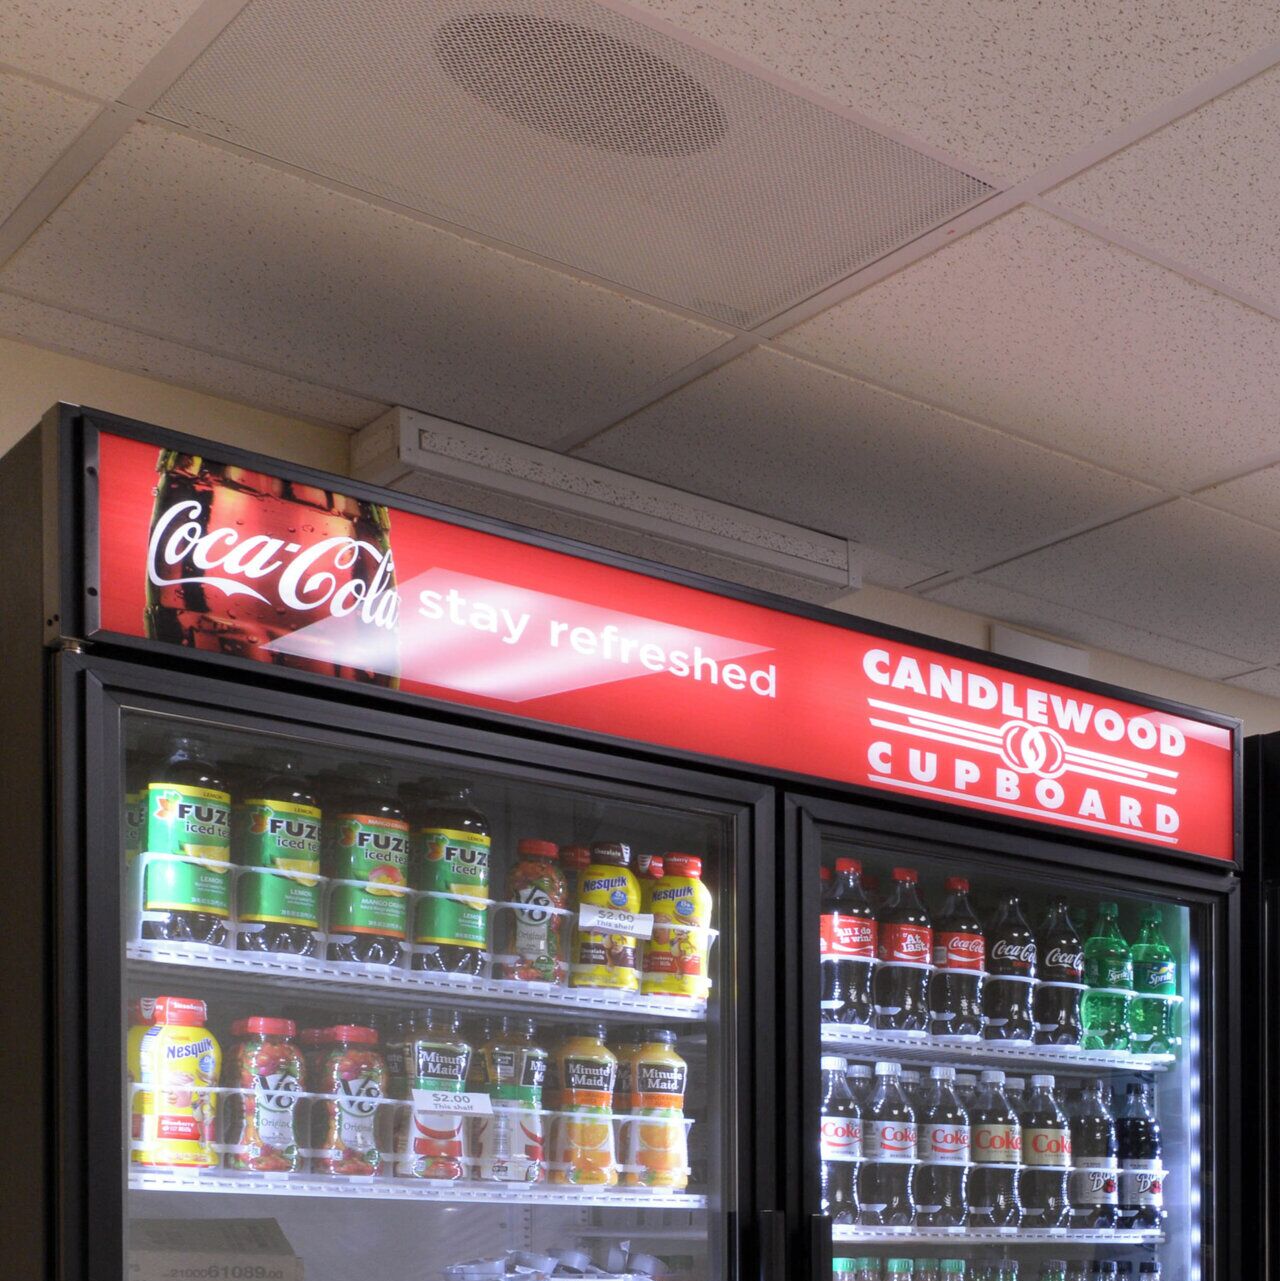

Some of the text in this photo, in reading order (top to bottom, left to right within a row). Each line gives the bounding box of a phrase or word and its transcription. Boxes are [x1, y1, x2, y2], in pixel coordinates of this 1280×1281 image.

[149, 499, 399, 632] Coca-Cola
[419, 588, 778, 699] stay refreshed
[862, 648, 1187, 757] CANDLEWOOD
[867, 741, 1180, 834] CUPBOARD
[178, 804, 231, 826] FUZ
[186, 821, 214, 835] iced
[269, 818, 321, 839] FUZ
[277, 836, 304, 849] iced
[365, 849, 391, 862] iced
[445, 846, 490, 867] FUZ
[452, 863, 481, 875] iced
[583, 876, 627, 892] Nesquik
[652, 886, 693, 901] Nesquik
[598, 910, 634, 923] $2.00
[167, 1039, 213, 1060] Nesquik
[428, 1063, 459, 1075] Maid
[643, 1068, 682, 1081] Minute
[574, 1074, 604, 1087] Maid
[648, 1078, 678, 1091] Maid
[432, 1092, 470, 1104] $2.00
[822, 1121, 861, 1139] Coke
[881, 1125, 918, 1143] Coke
[931, 1128, 969, 1146] Coke
[975, 1129, 1023, 1152] Coke
